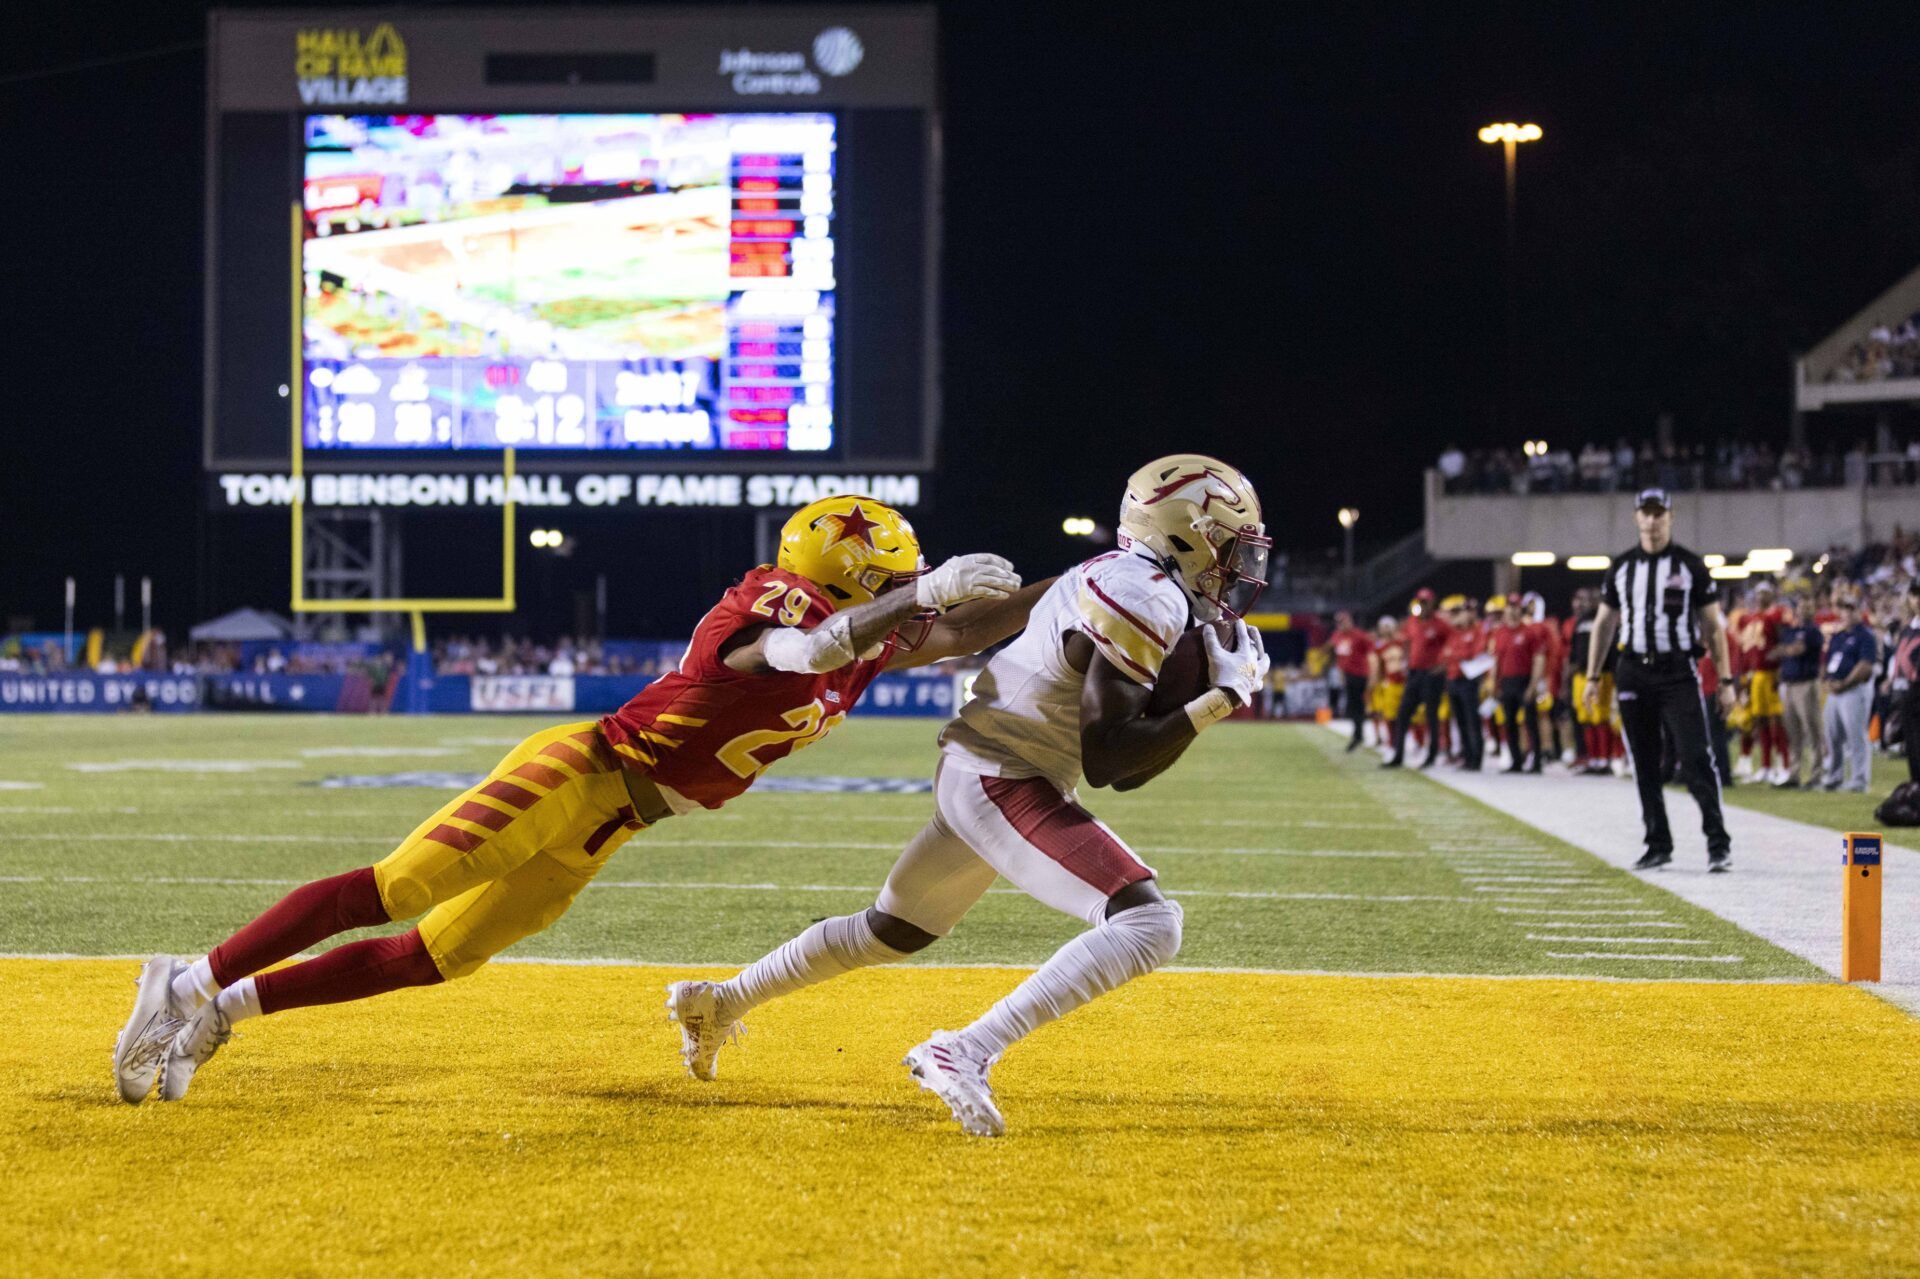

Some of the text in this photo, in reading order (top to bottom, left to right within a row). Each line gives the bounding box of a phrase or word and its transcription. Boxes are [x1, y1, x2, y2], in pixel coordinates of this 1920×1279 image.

[719, 48, 805, 75] Johnson
[298, 76, 408, 104] VILLAGE
[732, 71, 821, 94] Controls
[220, 474, 919, 506] TOM BENSON HALL OF FAME STADIUM
[751, 580, 812, 627] 29
[2, 680, 95, 704] UNITED
[104, 680, 136, 704] BY
[874, 684, 909, 707] BY
